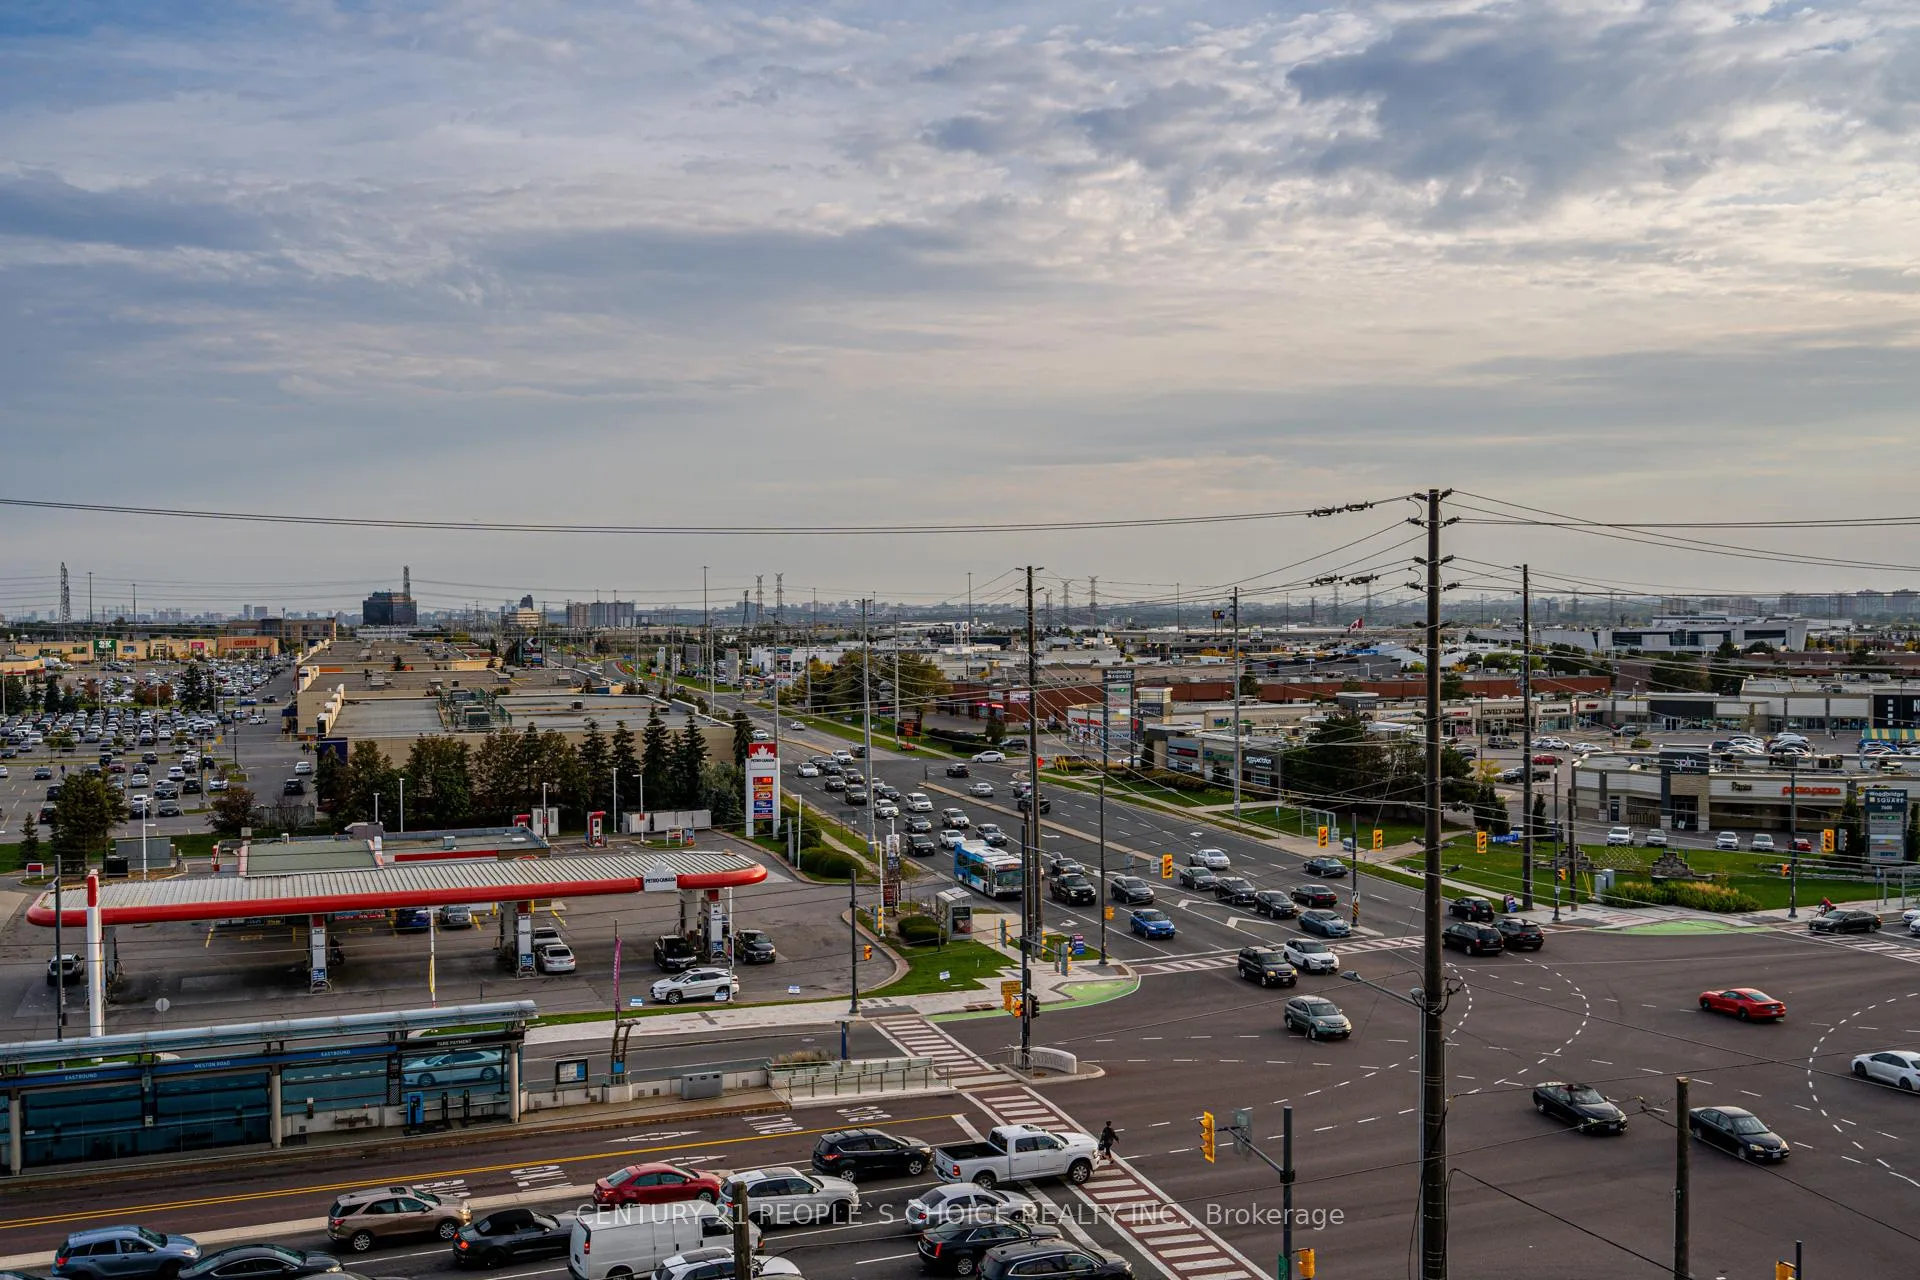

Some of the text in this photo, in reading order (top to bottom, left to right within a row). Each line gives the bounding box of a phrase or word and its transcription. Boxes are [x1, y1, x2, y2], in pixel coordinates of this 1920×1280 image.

[1674, 755, 1697, 771] spin
[450, 1038, 473, 1046] PAYMENT
[321, 1049, 351, 1057] EASTBOUND
[65, 1072, 98, 1081] EASTBOUND
